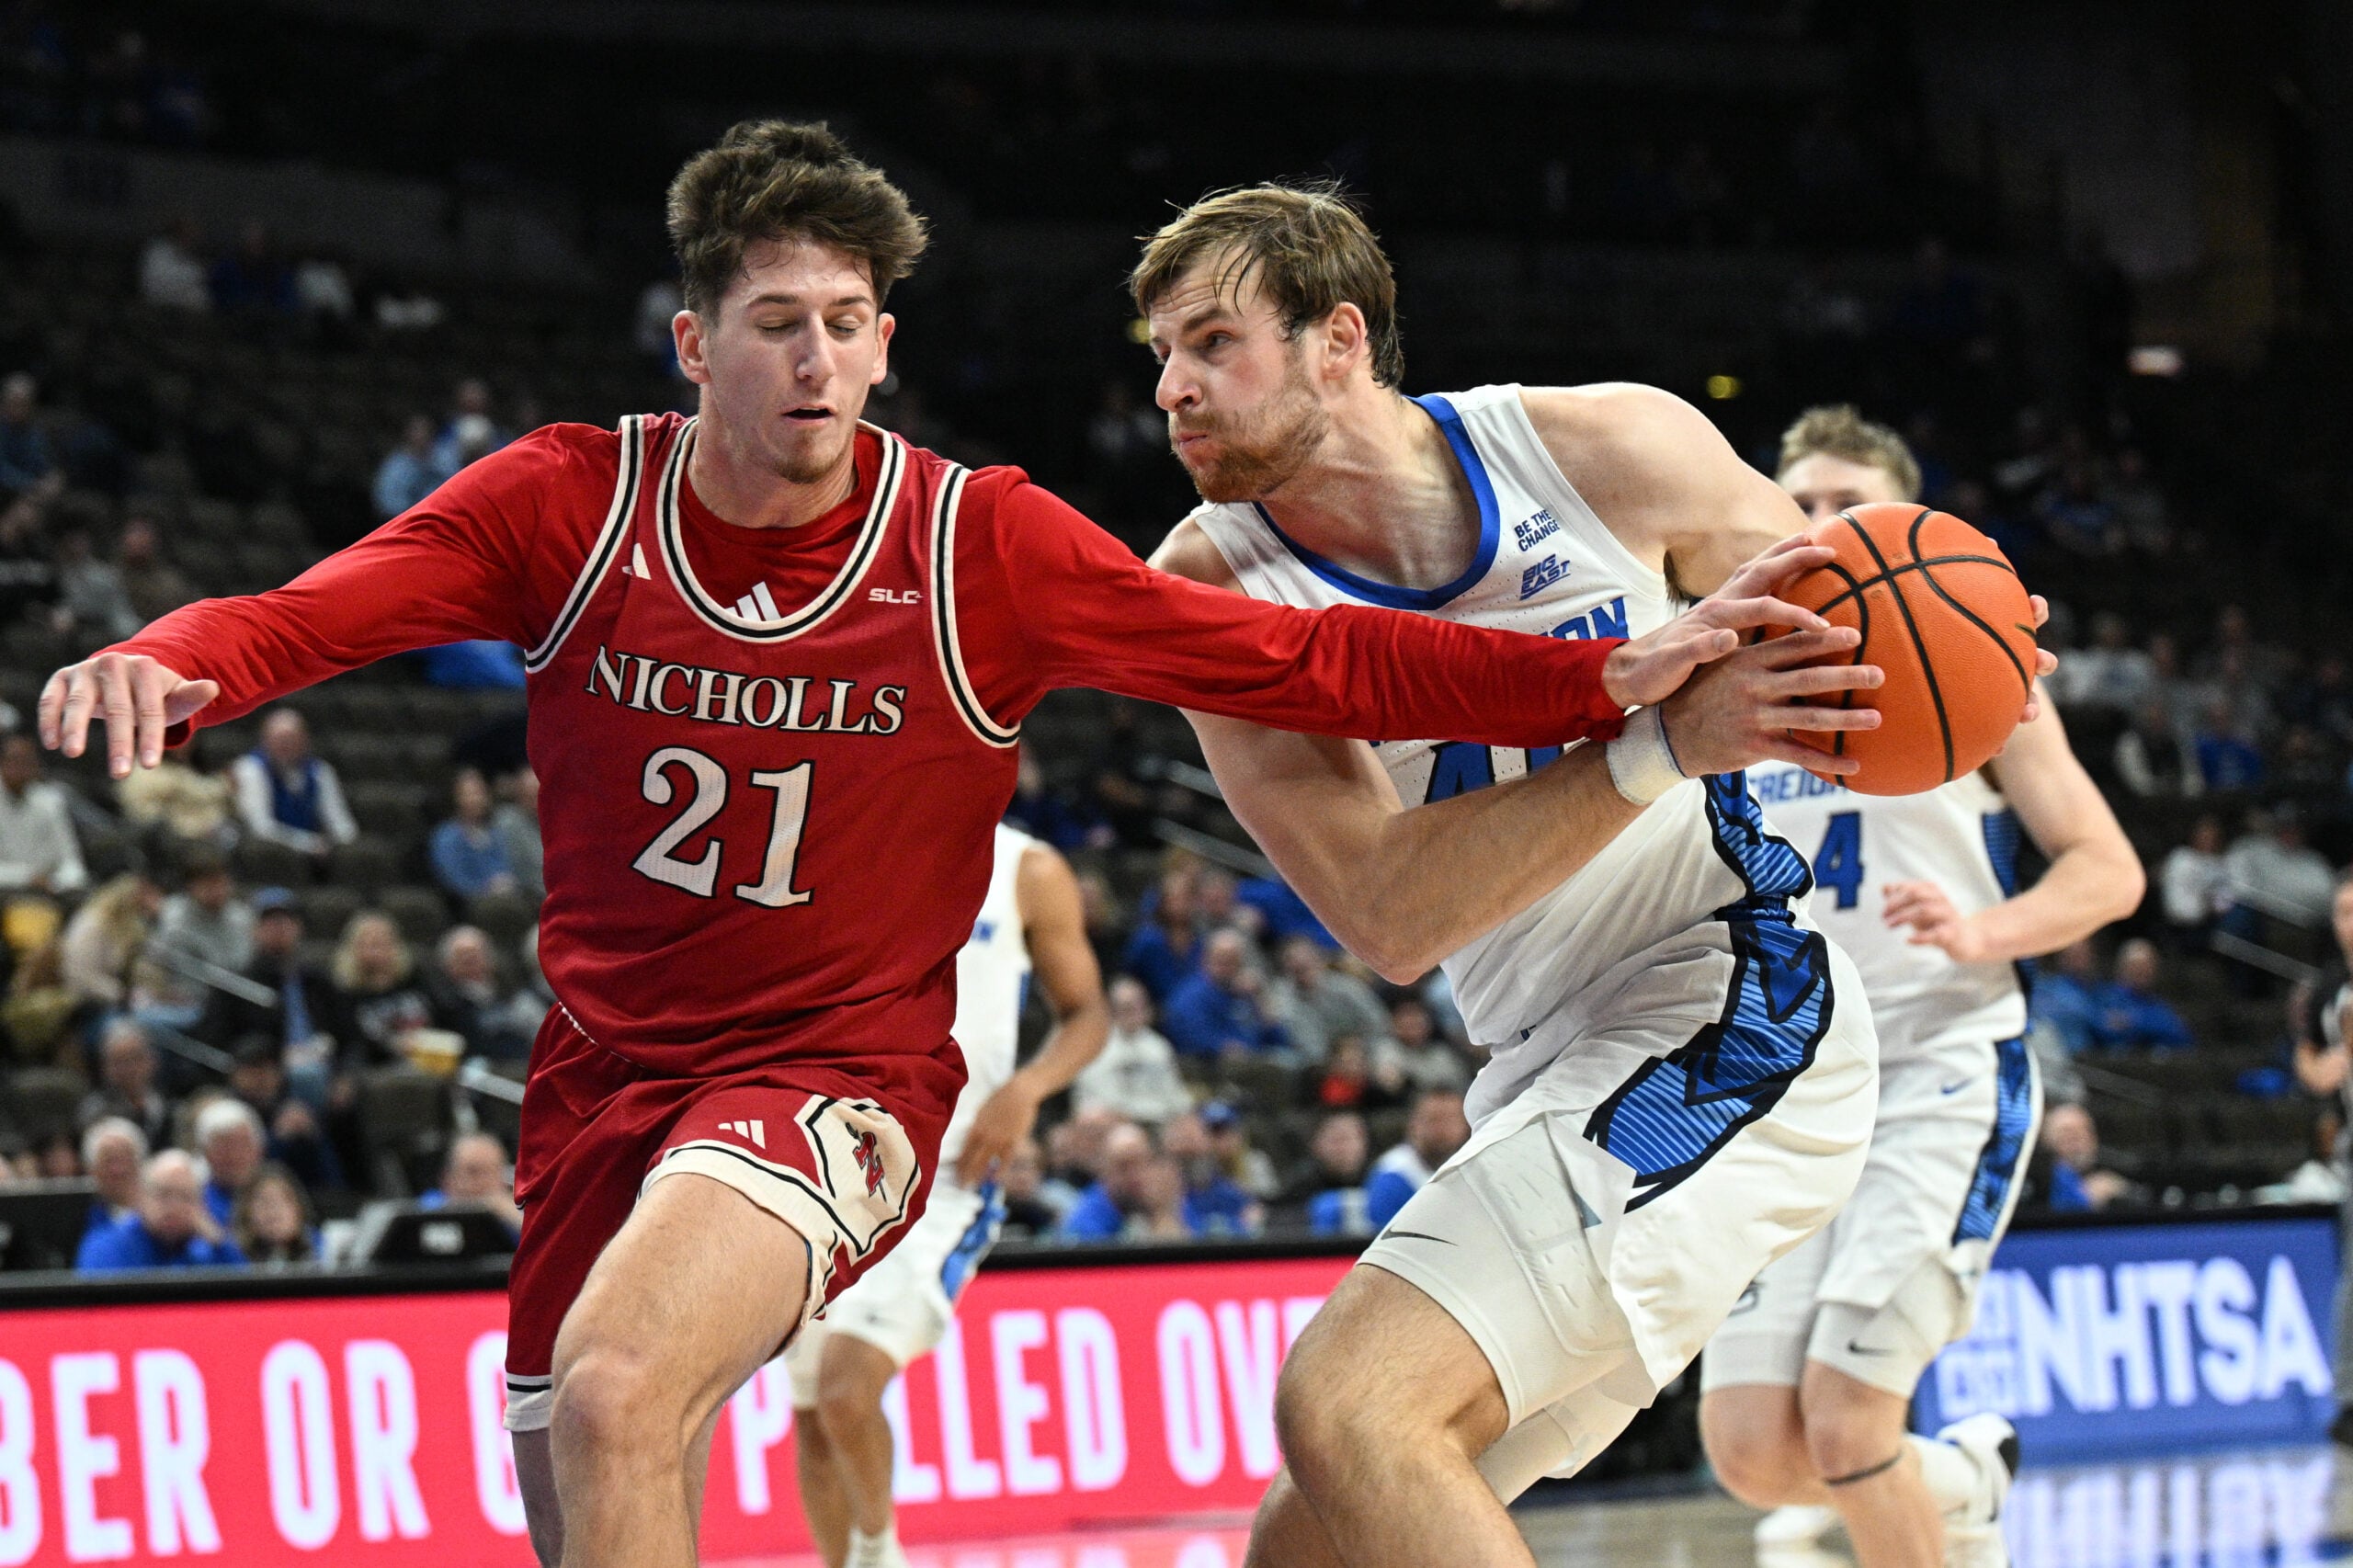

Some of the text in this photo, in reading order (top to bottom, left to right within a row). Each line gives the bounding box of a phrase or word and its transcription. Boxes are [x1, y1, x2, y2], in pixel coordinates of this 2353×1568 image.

[1513, 509, 1552, 540] BE THE
[1518, 519, 1561, 552] CHANGE
[867, 587, 922, 604] SLC
[1520, 560, 1571, 596] EAST
[1523, 553, 1556, 582] BIG
[585, 644, 906, 735] NICHOLLS
[630, 745, 816, 909] 21
[1813, 809, 1865, 910] 4
[2011, 1254, 2335, 1419] NHTSA
[260, 1339, 431, 1551] OR
